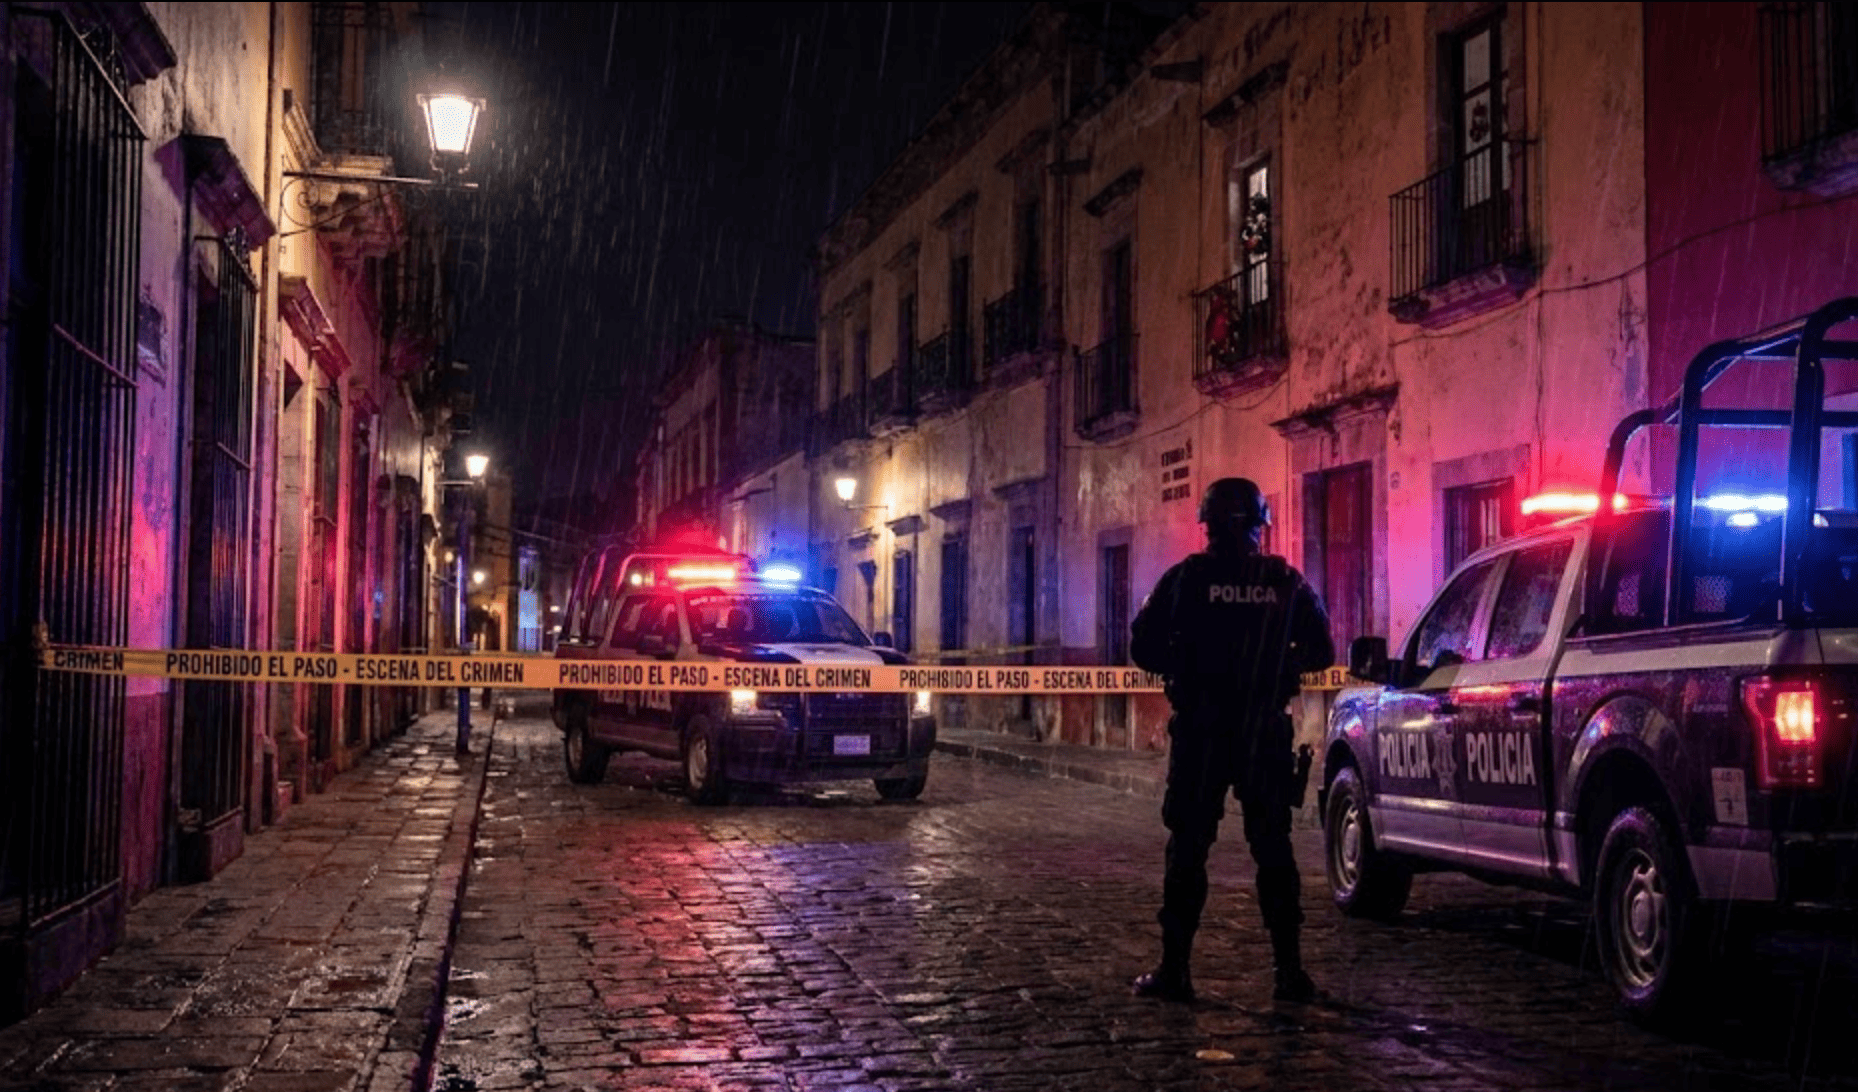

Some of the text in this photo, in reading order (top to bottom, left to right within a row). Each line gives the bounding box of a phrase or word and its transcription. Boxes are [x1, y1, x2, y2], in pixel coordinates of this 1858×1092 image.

[1209, 584, 1277, 603] POLICA
[54, 651, 124, 670] CRIMEN
[166, 653, 262, 676] PROHIBIDO
[268, 656, 288, 676] EL
[294, 657, 337, 678] PASO
[356, 658, 420, 680] ESCENA
[425, 661, 455, 681] DEL
[461, 661, 524, 682] CRIMEN
[559, 663, 643, 685] PROHIBIDO
[648, 665, 665, 685] EL
[670, 665, 708, 686] PASO
[724, 667, 781, 687] ESCENA
[785, 668, 811, 687] DEL
[815, 669, 871, 688] CRIMEN
[977, 671, 993, 689] EL
[997, 671, 1029, 689] PASO
[1043, 671, 1093, 689] ESCENA
[1097, 671, 1119, 689] DEL
[1379, 732, 1431, 779] POLICIA
[1466, 731, 1537, 786] POLICIA
